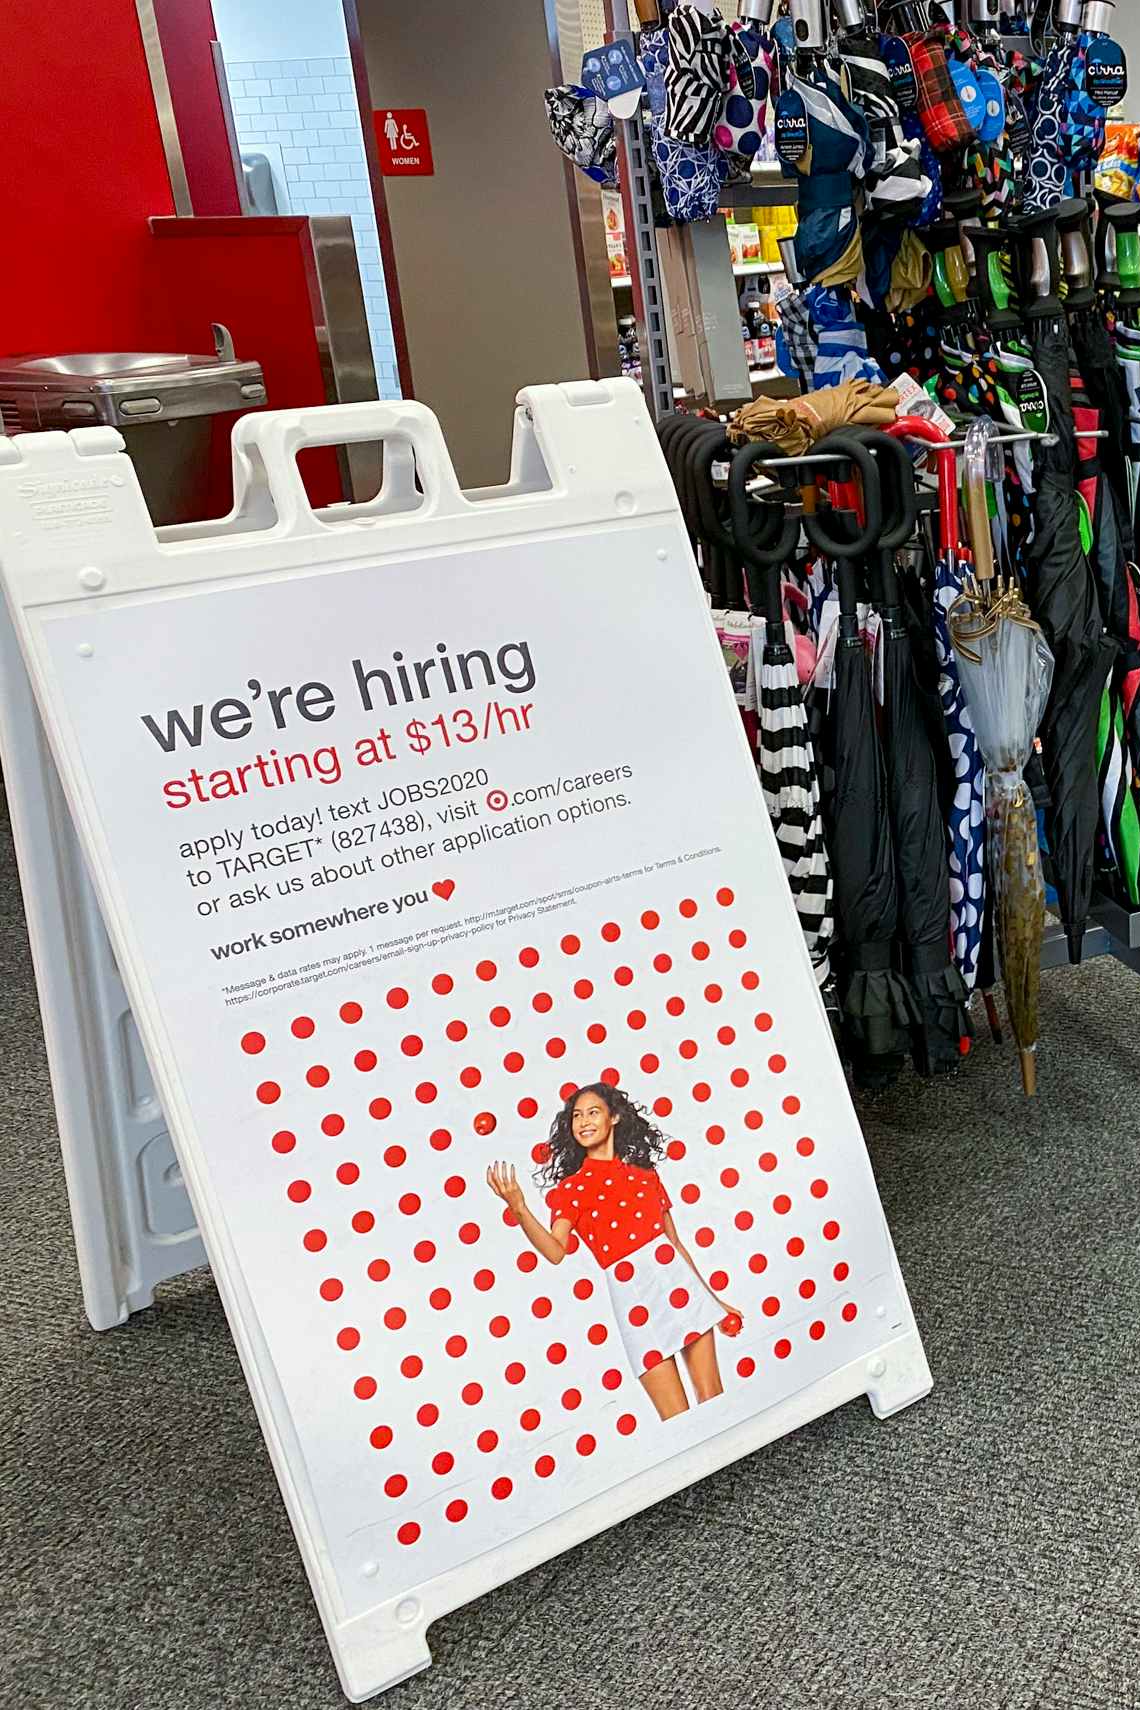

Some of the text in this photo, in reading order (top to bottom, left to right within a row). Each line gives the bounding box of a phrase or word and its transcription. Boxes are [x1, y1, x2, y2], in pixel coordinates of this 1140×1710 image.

[1088, 64, 1125, 75] cirra
[391, 157, 420, 165] WOMEN
[777, 117, 806, 129] cirra
[140, 641, 535, 752] we're hiring
[163, 700, 535, 808] starting at $13/hr
[179, 768, 488, 859] apply today! text JOBS2020
[186, 858, 211, 886] to
[331, 810, 432, 852] (827438),
[436, 799, 479, 823] visit
[197, 794, 631, 916] or ask us about other application options.
[210, 890, 428, 960] work somewhere you
[268, 973, 275, 981] &
[276, 967, 298, 979] data
[298, 959, 321, 973] rates
[322, 955, 342, 967] may
[376, 935, 415, 951] message
[415, 928, 429, 942] per
[654, 859, 676, 869] Terms
[677, 855, 683, 863] &
[494, 912, 506, 927] for
[507, 904, 535, 923] Privacy
